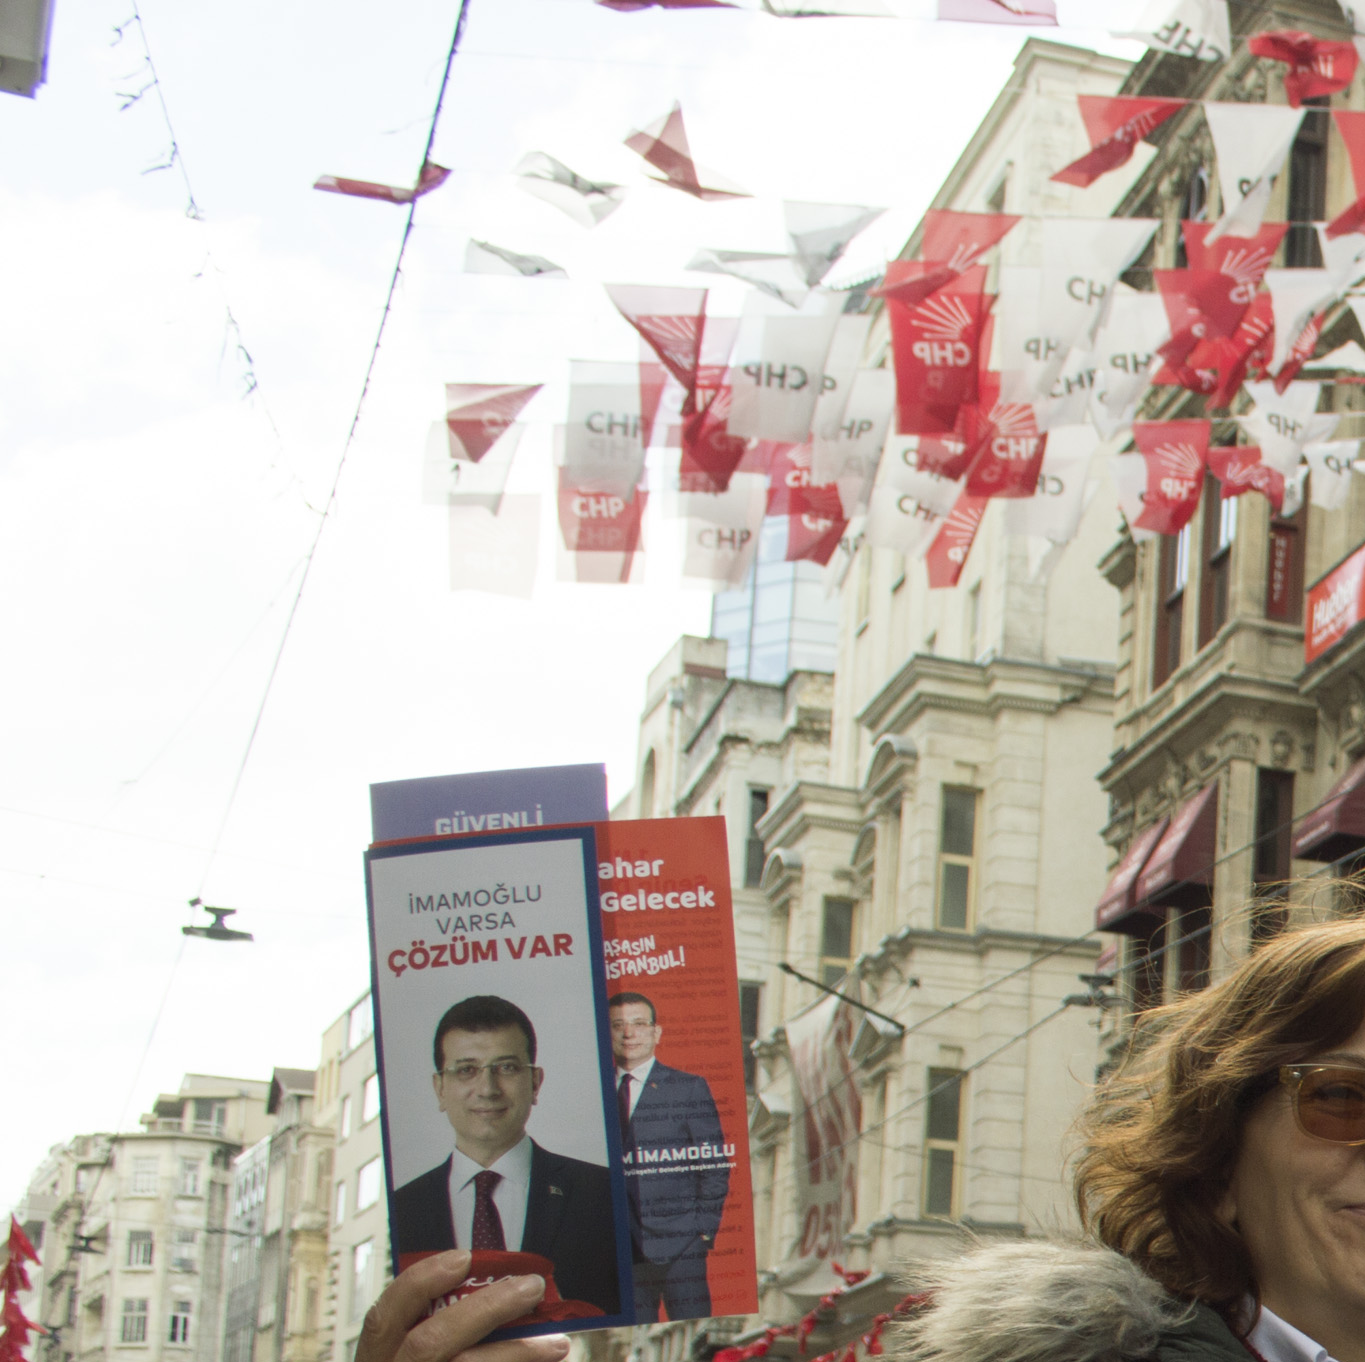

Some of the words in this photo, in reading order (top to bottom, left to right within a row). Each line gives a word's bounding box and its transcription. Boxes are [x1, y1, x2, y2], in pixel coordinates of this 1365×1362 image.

[571, 496, 626, 519] CHP
[697, 527, 753, 551] CHP
[435, 804, 544, 836] GÜVENLİ
[598, 856, 665, 880] ahar
[408, 883, 543, 914] İMAMOĞLU
[600, 885, 715, 913] Gelecek
[436, 912, 516, 935] VARSA
[387, 935, 499, 978] ÇÖZÜM
[504, 933, 574, 960] VAR
[603, 934, 656, 957] AŞASIN
[604, 945, 686, 980] İSTANBUL!
[637, 1142, 736, 1164] İMAMOĞLU
